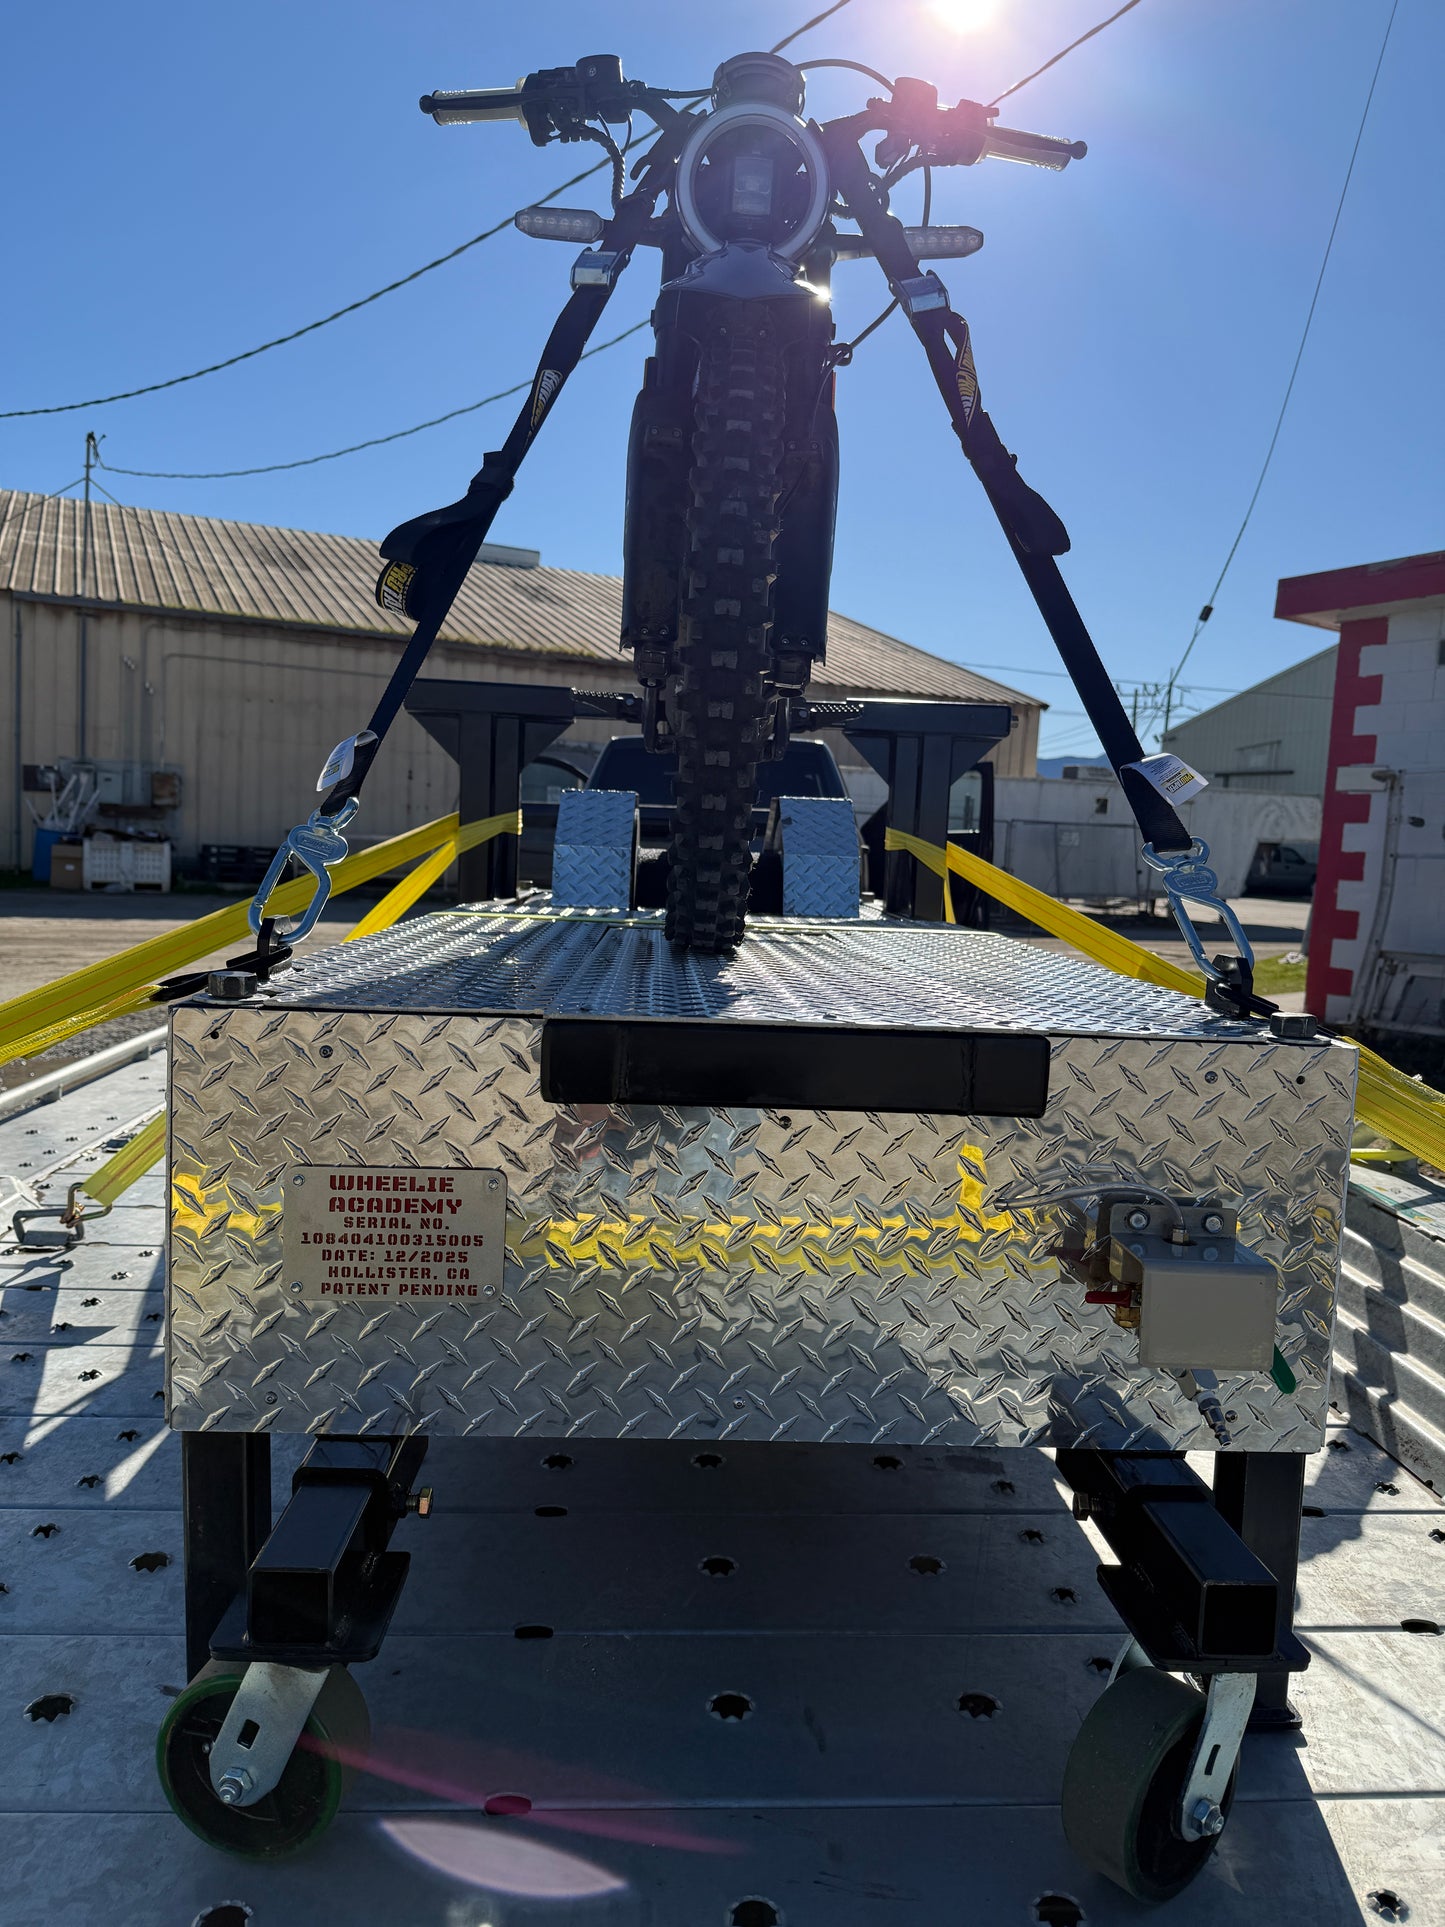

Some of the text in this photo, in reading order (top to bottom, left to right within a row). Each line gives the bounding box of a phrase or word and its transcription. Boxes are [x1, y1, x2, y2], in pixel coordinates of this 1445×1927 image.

[330, 1175, 454, 1192] WHEELIE
[329, 1197, 462, 1214] ACADEMY
[344, 1217, 449, 1230] SERIAL NO.
[301, 1232, 483, 1247] 108404100315005
[322, 1249, 468, 1263] DATE: 12/2025
[447, 1268, 470, 1280] CA
[321, 1283, 478, 1296] PATENT PENDING
